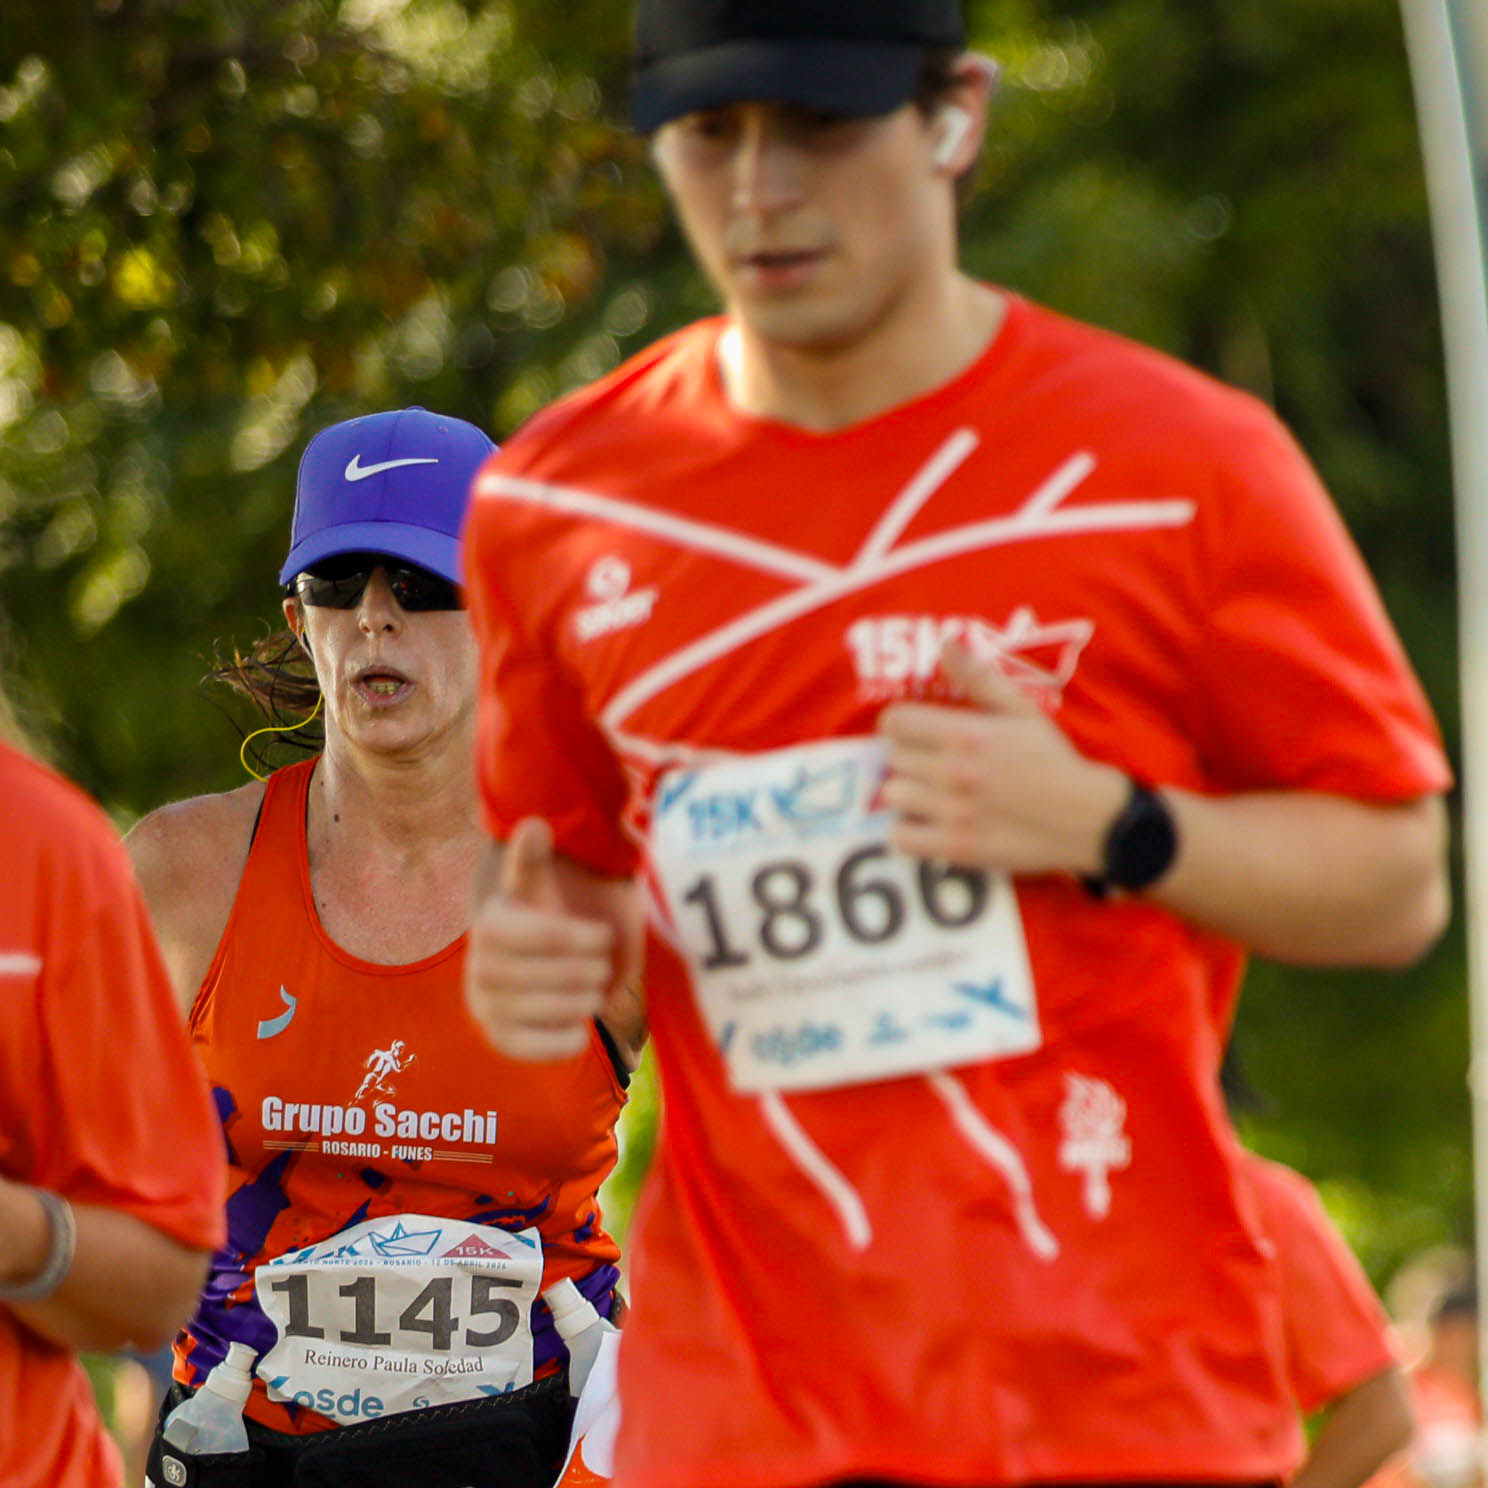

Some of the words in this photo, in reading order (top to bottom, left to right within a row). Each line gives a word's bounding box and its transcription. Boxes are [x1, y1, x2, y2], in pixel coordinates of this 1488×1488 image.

[685, 842, 990, 973] 1866
[261, 1096, 367, 1137] Grupo
[374, 1102, 498, 1145] Sacchi
[322, 1140, 381, 1157] ROSARIO
[391, 1145, 433, 1161] FUNES
[383, 1259, 422, 1267] ROSARIO
[455, 1245, 495, 1256] 15K
[271, 1273, 524, 1350] 1145
[304, 1349, 368, 1370] Reinero
[373, 1355, 418, 1374] Paula
[290, 1388, 385, 1418] osde
